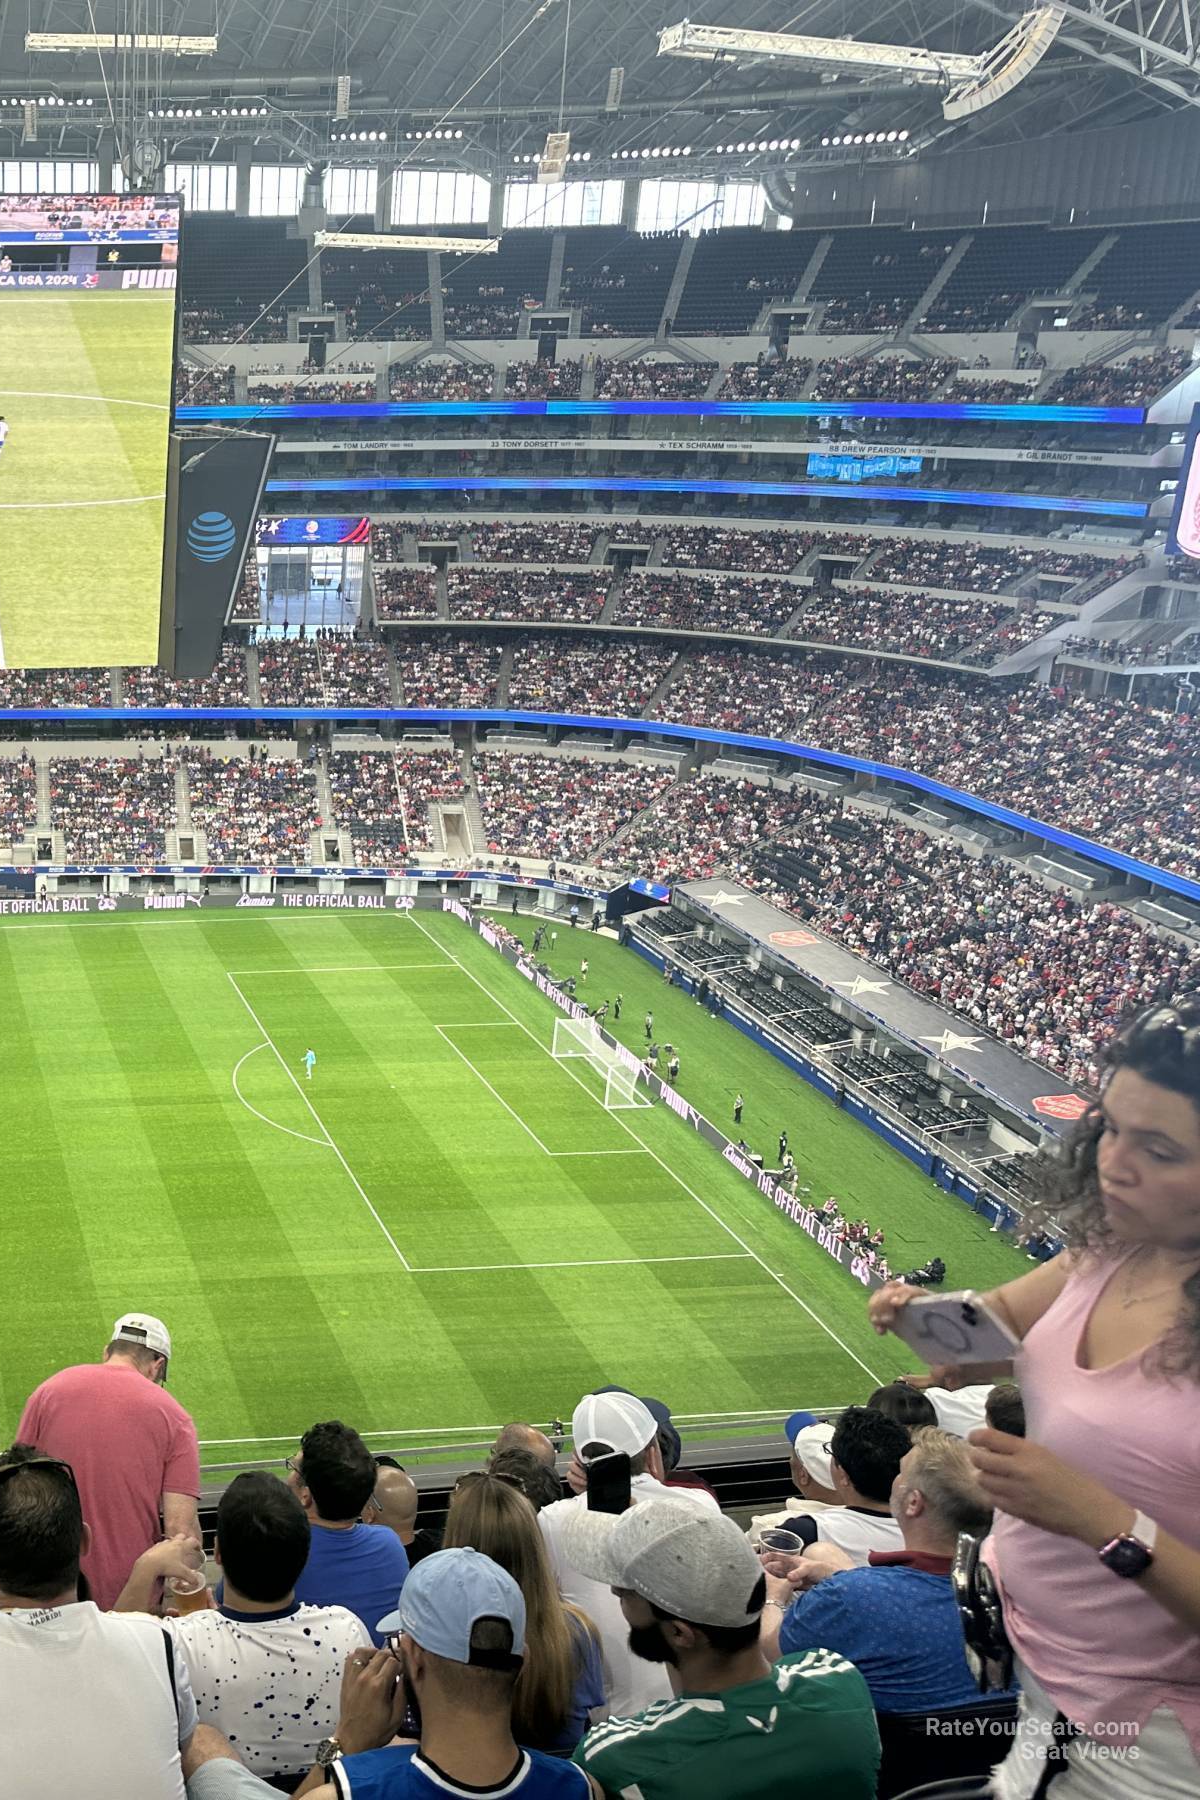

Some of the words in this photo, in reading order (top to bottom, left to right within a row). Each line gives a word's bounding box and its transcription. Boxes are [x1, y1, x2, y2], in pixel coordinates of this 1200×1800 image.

[18, 274, 43, 286] USA
[45, 274, 77, 286] 2024
[1026, 452, 1039, 460] GIL
[1040, 453, 1073, 461] BRANDT
[13, 899, 60, 914] OFFICIAL
[62, 898, 90, 912] BALL
[144, 894, 185, 909] PUMA
[282, 894, 303, 907] THE
[305, 894, 355, 908] OFFICIAL
[357, 895, 386, 909] BALL
[536, 971, 547, 993] THE
[757, 1170, 775, 1199] THE
[775, 1186, 818, 1239] OFFICIAL
[817, 1225, 843, 1264] BALL
